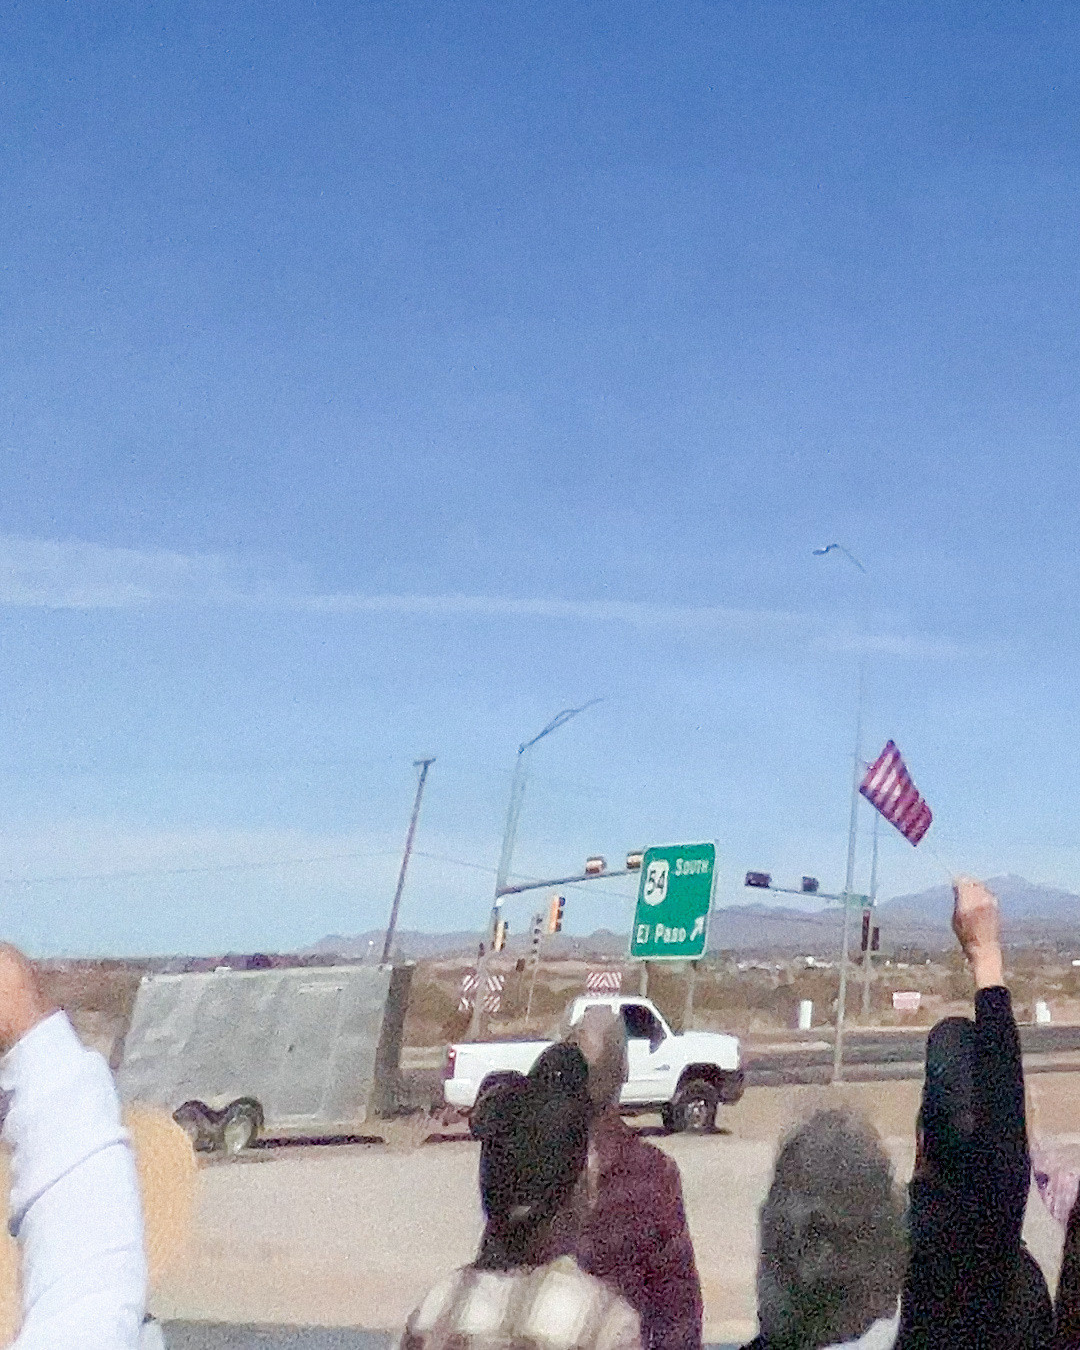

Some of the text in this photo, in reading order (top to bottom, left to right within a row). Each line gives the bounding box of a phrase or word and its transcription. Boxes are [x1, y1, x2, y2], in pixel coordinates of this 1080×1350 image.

[646, 869, 666, 895] 54
[636, 923, 687, 944] El Paso
